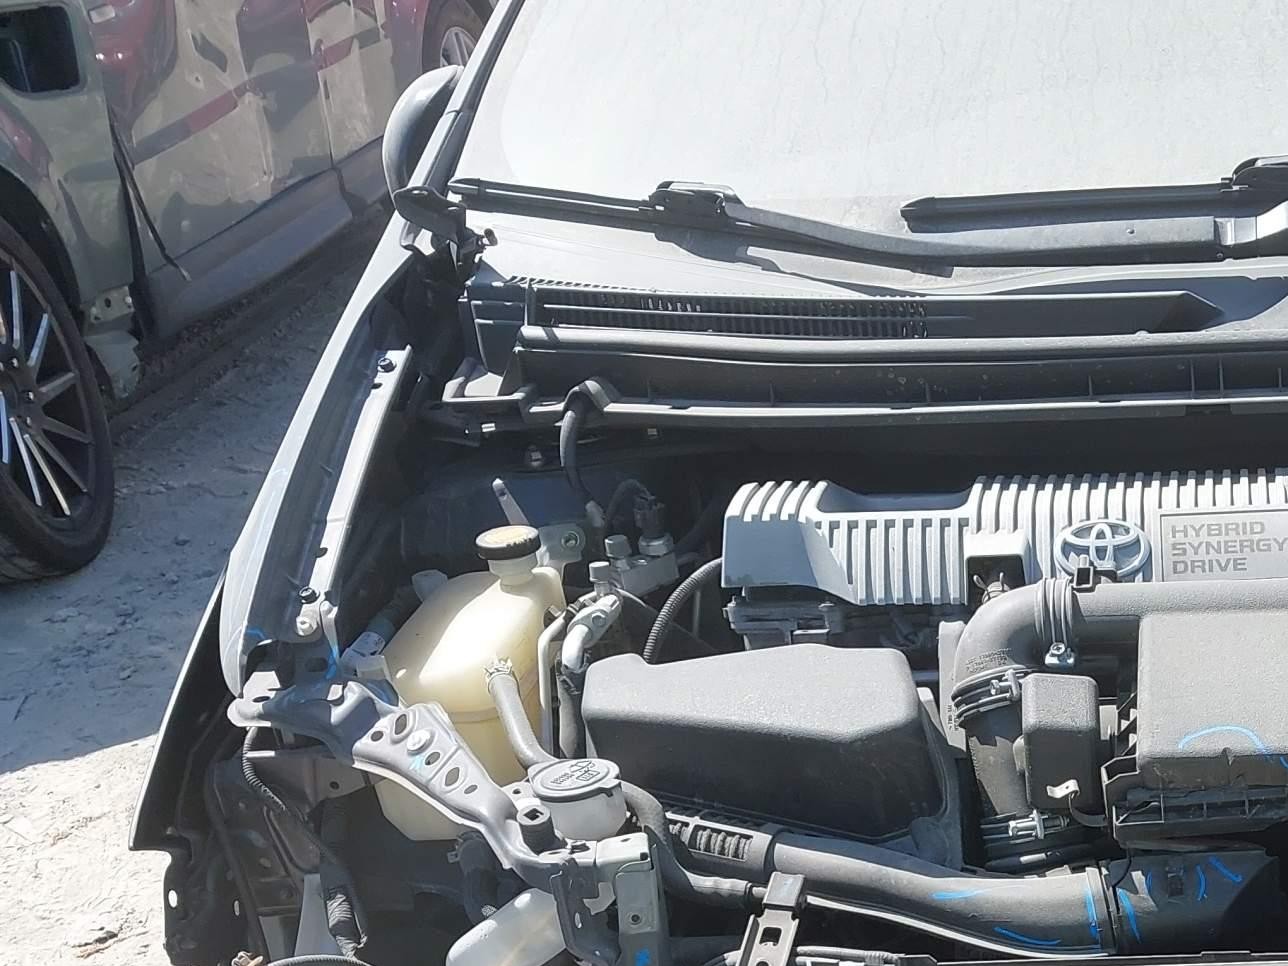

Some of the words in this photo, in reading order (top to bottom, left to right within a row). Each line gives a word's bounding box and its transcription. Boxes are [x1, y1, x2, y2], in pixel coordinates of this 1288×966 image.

[1171, 521, 1266, 539] HYBRID
[1171, 537, 1288, 557] SYNERGY
[1172, 557, 1248, 575] DRIVE
